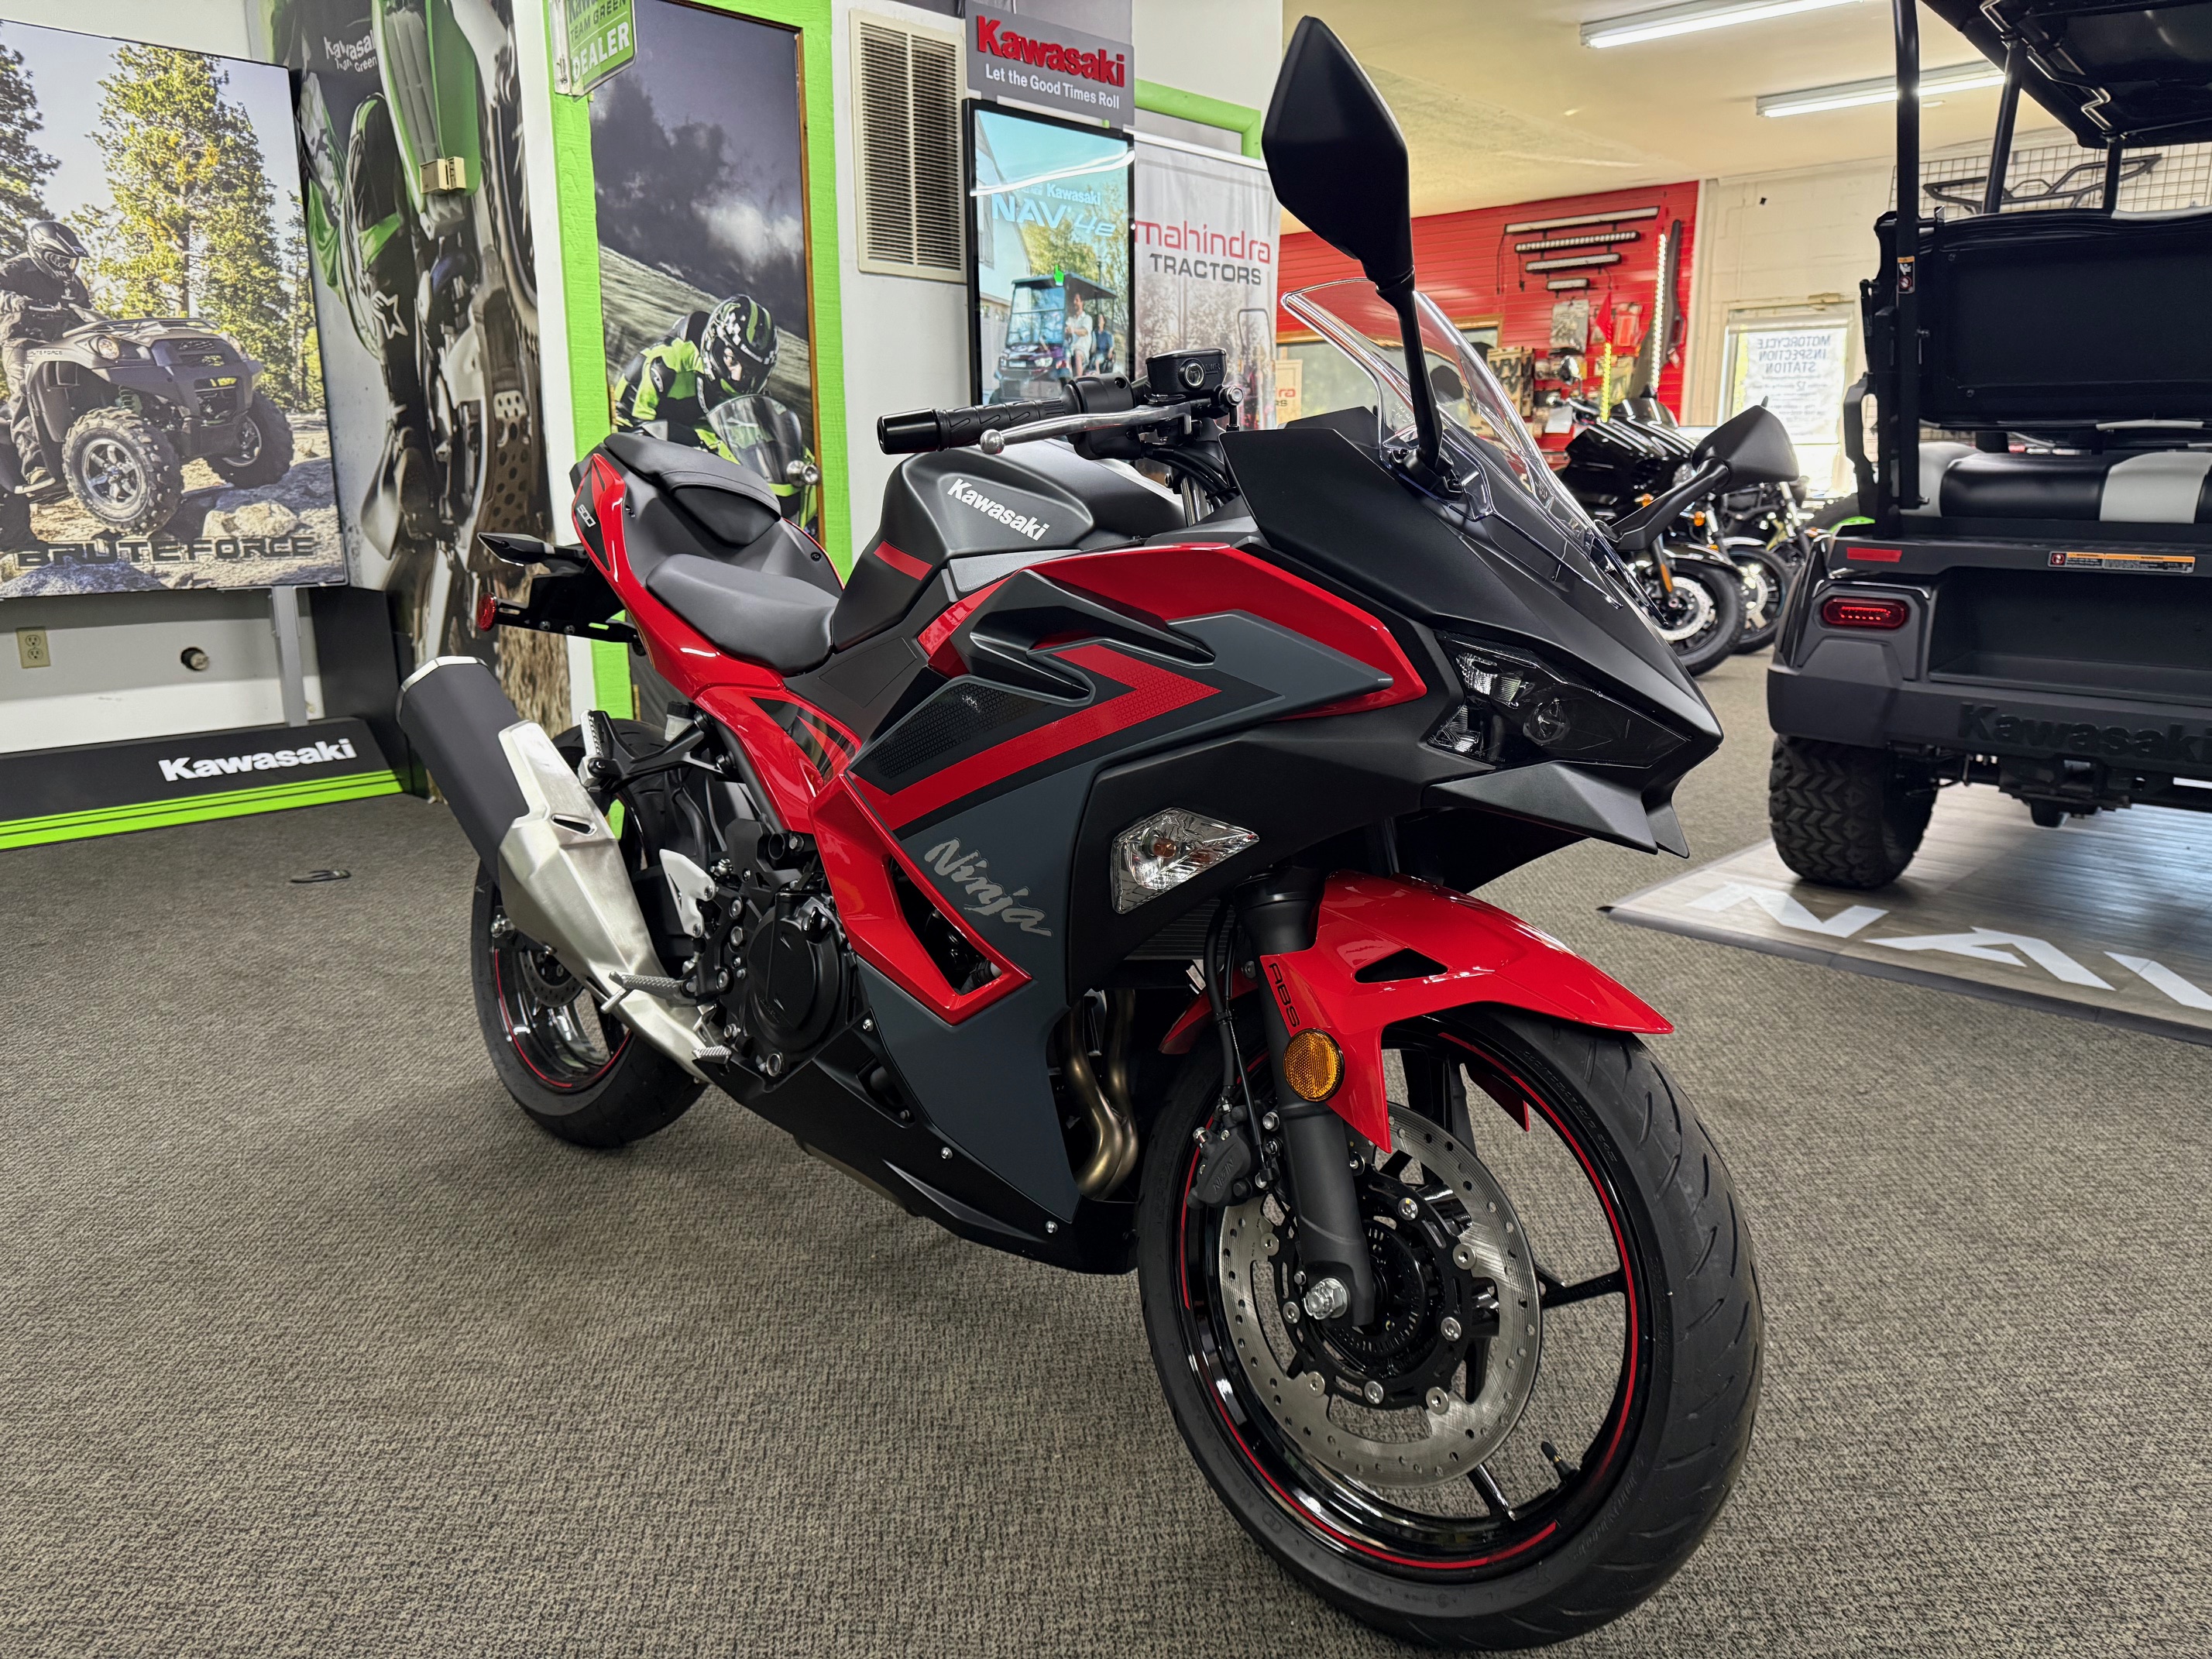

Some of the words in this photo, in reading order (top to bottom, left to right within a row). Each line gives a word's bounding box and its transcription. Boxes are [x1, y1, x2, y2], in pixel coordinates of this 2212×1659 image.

[570, 14, 591, 43] TEAM
[593, 0, 626, 24] GREEN
[324, 29, 376, 60] Kawasa
[354, 56, 378, 72] Green
[572, 22, 630, 82] DEALER
[977, 15, 1125, 88] Kawasaki
[985, 64, 1005, 82] Let
[1008, 68, 1028, 88] the
[1029, 77, 1061, 95] Good
[1063, 83, 1096, 104] Times
[1098, 91, 1120, 109] Roll
[1046, 183, 1101, 205] Kawasaki
[1134, 220, 1271, 265] mahindra
[1149, 252, 1262, 287] TRACTORS
[576, 504, 596, 527] 500
[947, 478, 1050, 541] Kawasaki
[1958, 701, 2212, 762] Kawasaki
[158, 738, 358, 782] Kawasaki
[924, 837, 1053, 937] Ninja
[1268, 963, 1300, 1028] ABS
